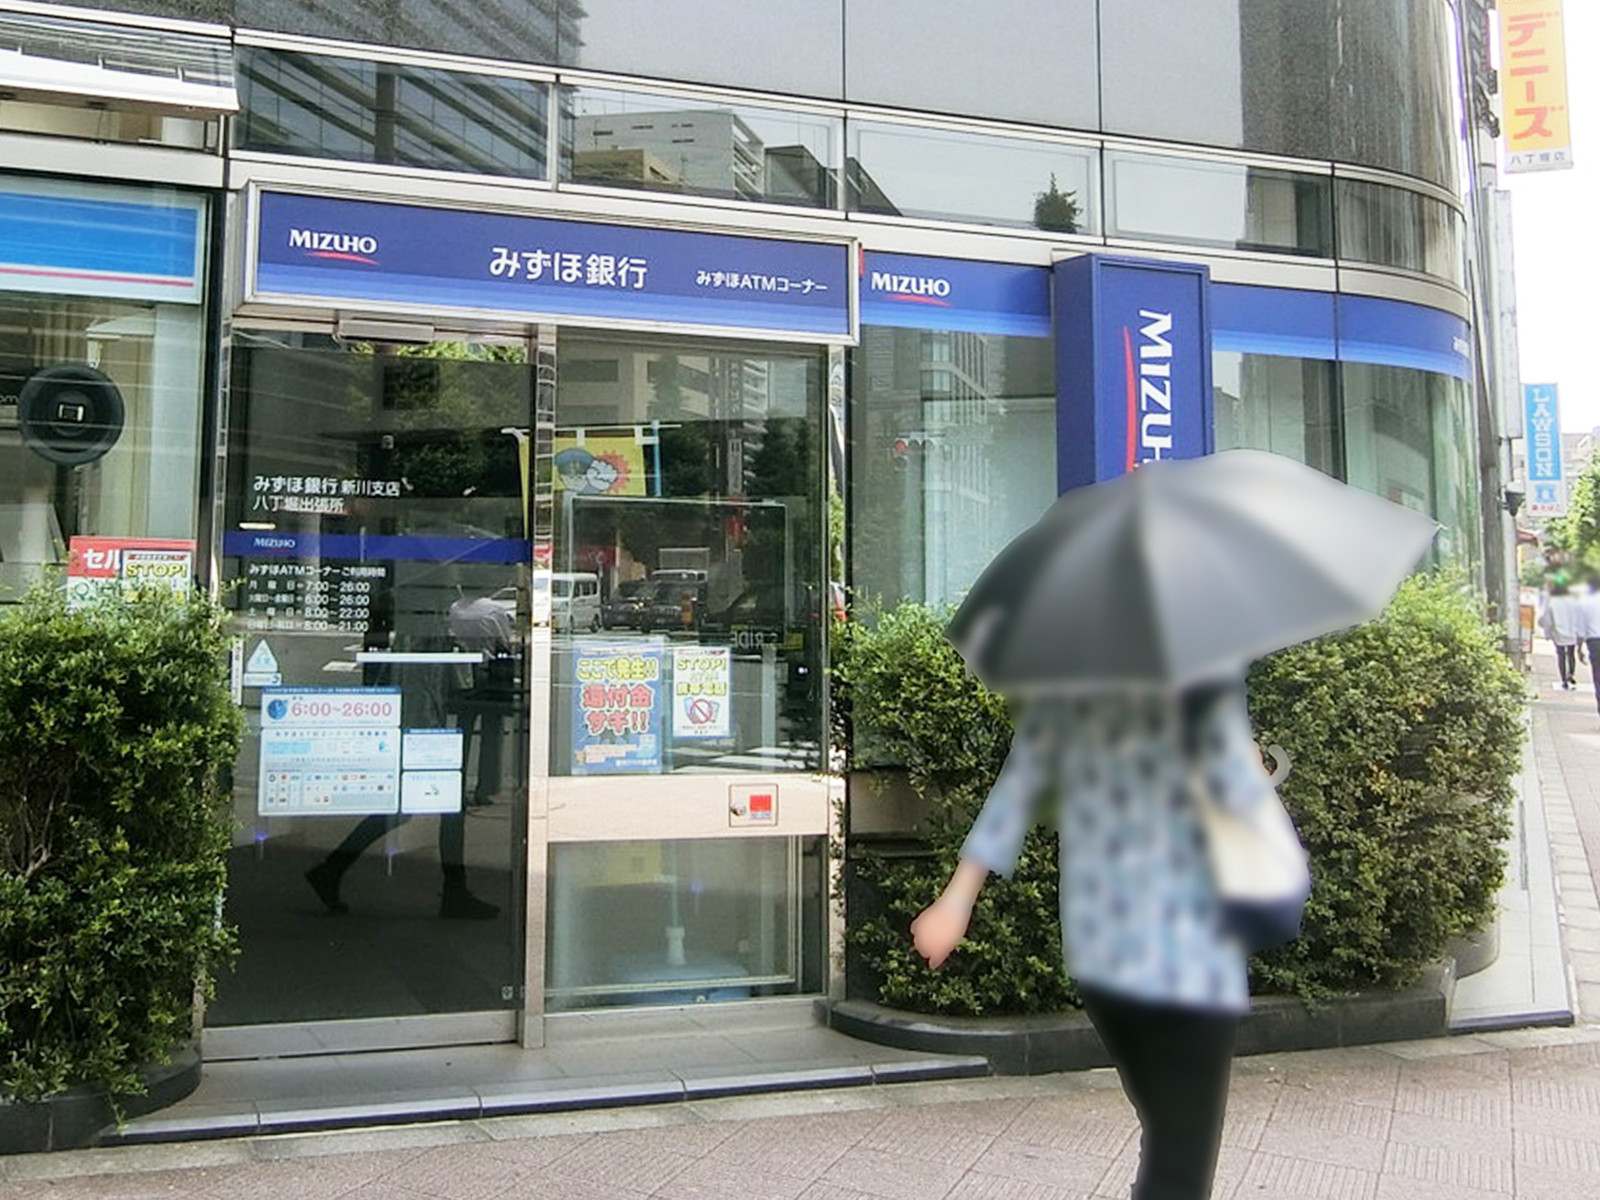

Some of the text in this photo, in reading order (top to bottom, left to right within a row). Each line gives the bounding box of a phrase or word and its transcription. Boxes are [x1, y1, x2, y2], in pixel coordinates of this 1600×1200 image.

[1508, 11, 1564, 140] デニーズ
[289, 229, 377, 255] MIZUHO
[489, 247, 648, 290] みずほ銀行
[696, 269, 828, 294] みずほATMコーナー
[871, 271, 951, 297] MIZUHO
[1532, 388, 1555, 477] LAWSON
[253, 475, 338, 495] みずほ銀行
[253, 537, 296, 549] MIZUHO
